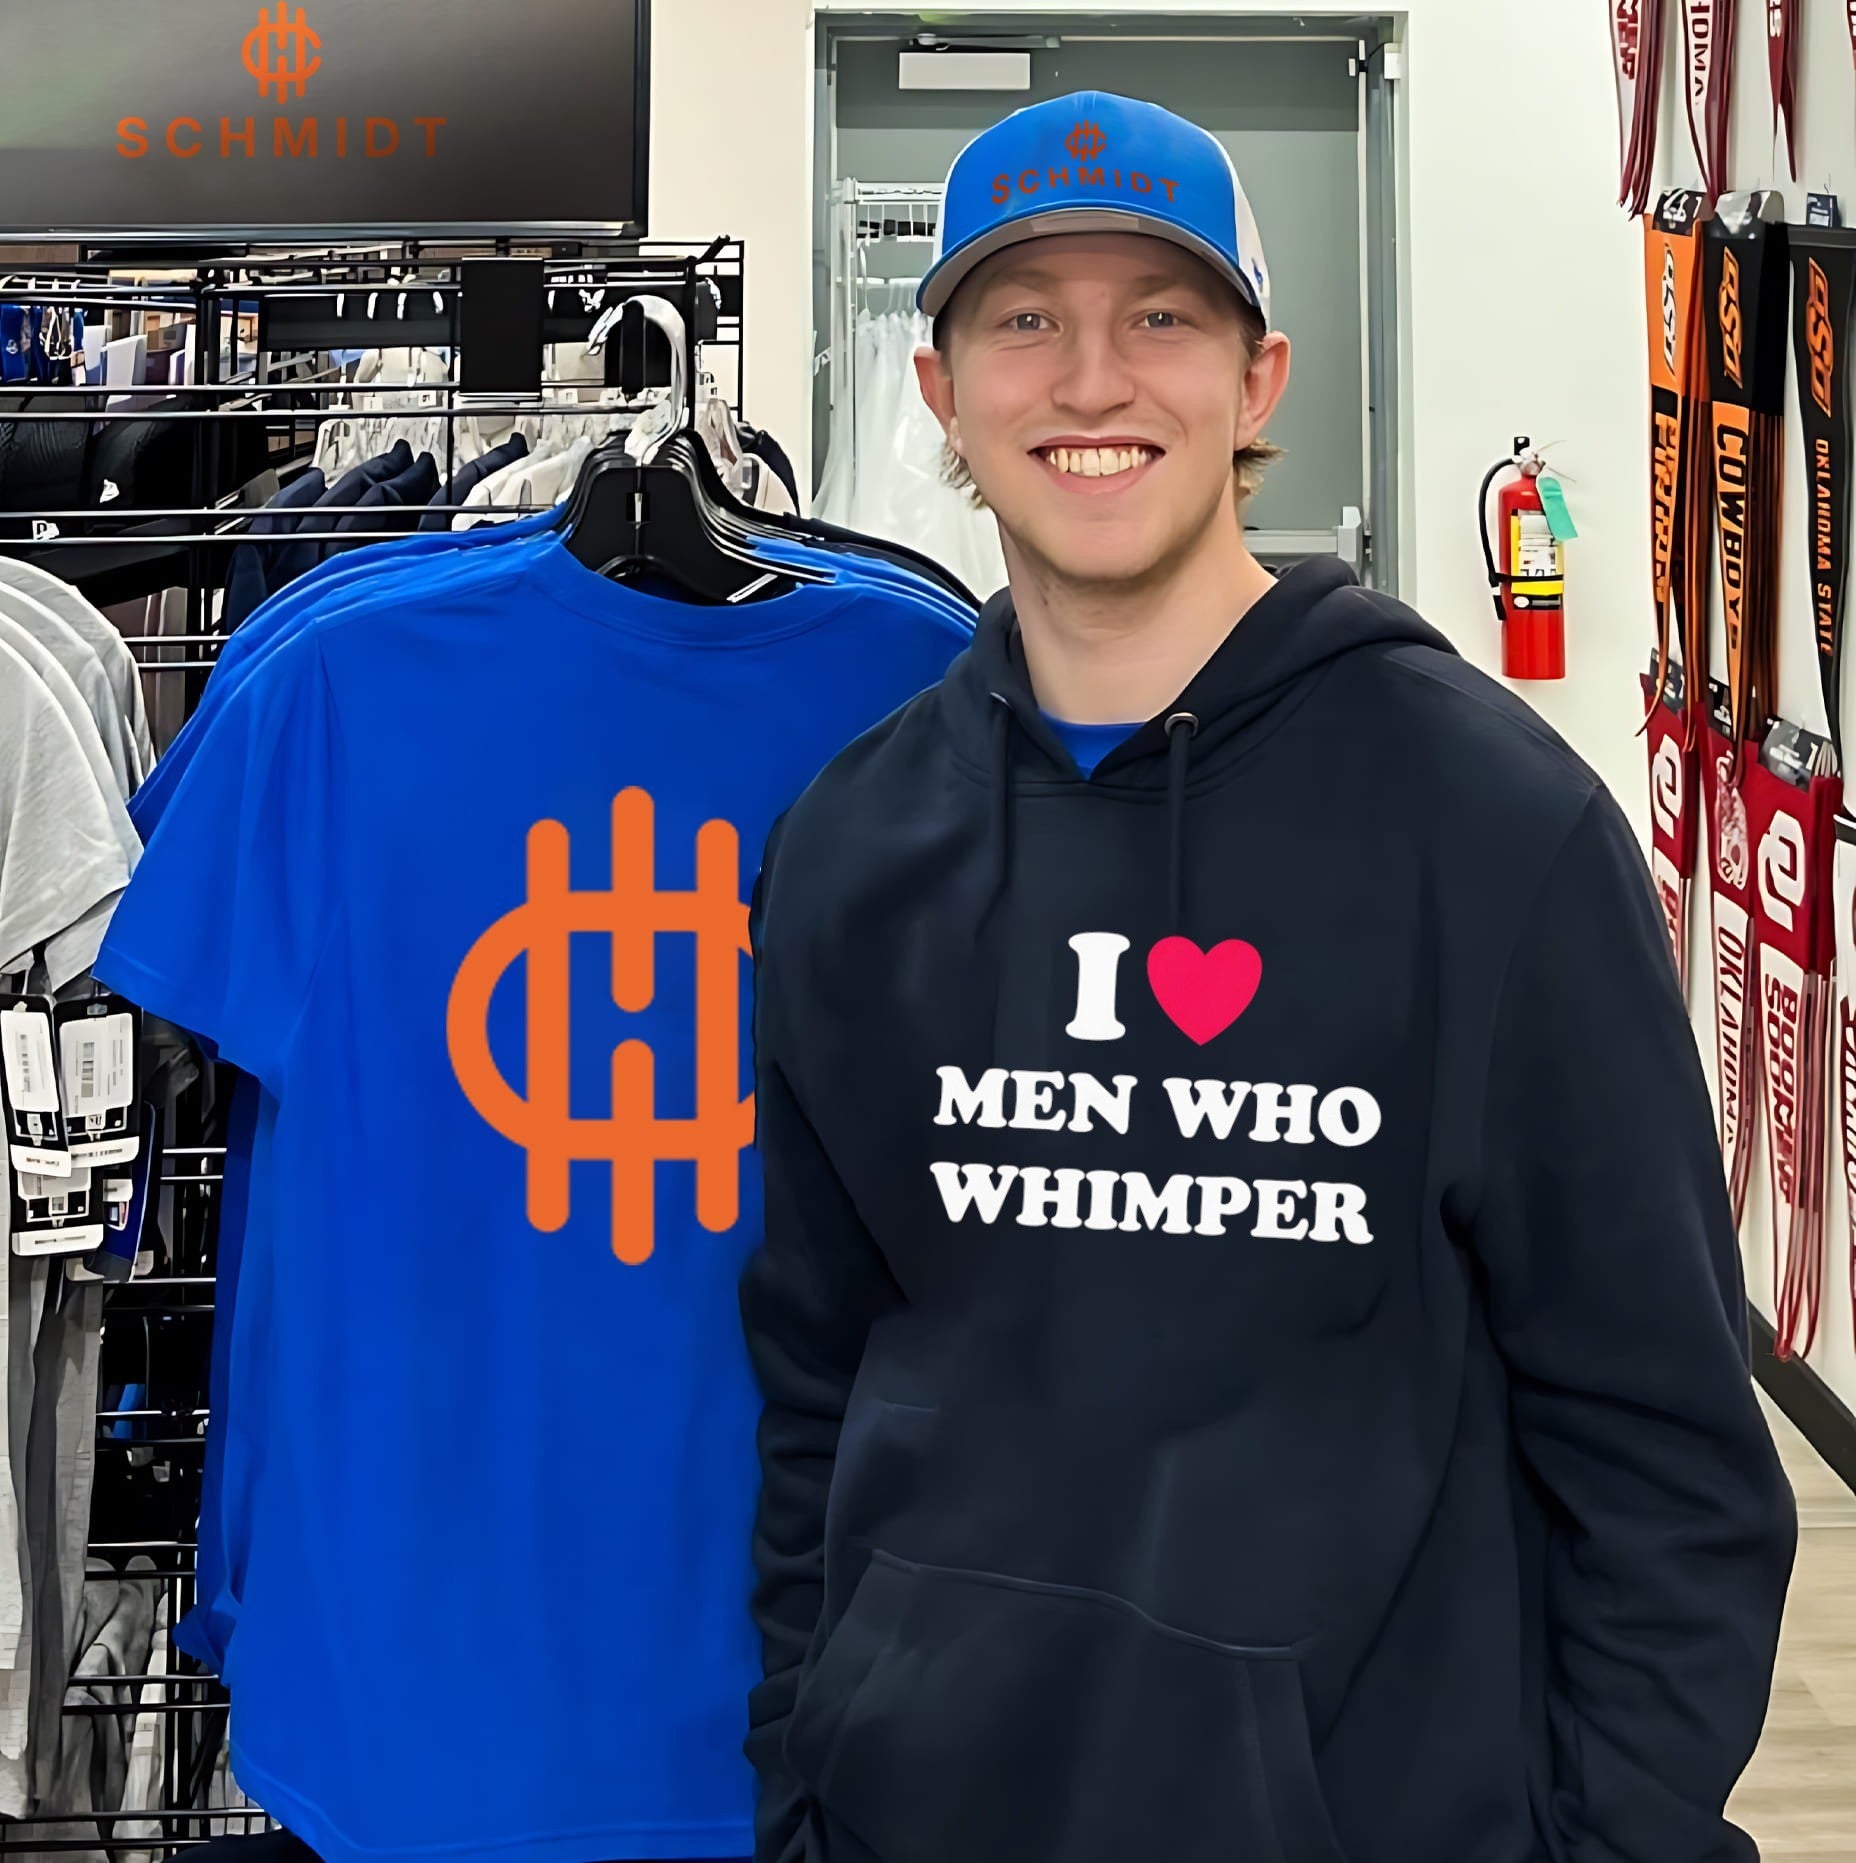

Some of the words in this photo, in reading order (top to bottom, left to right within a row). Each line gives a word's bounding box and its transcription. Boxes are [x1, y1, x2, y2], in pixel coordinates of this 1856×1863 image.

[115, 116, 447, 158] SCHMIDT
[992, 166, 1179, 204] SCHMIDT
[1815, 438, 1832, 570] OKLAHOMA
[1065, 931, 1131, 1041] I
[933, 1065, 1138, 1135] MEN
[1162, 1077, 1382, 1147] WHO
[929, 1161, 1374, 1245] WHIMPER
